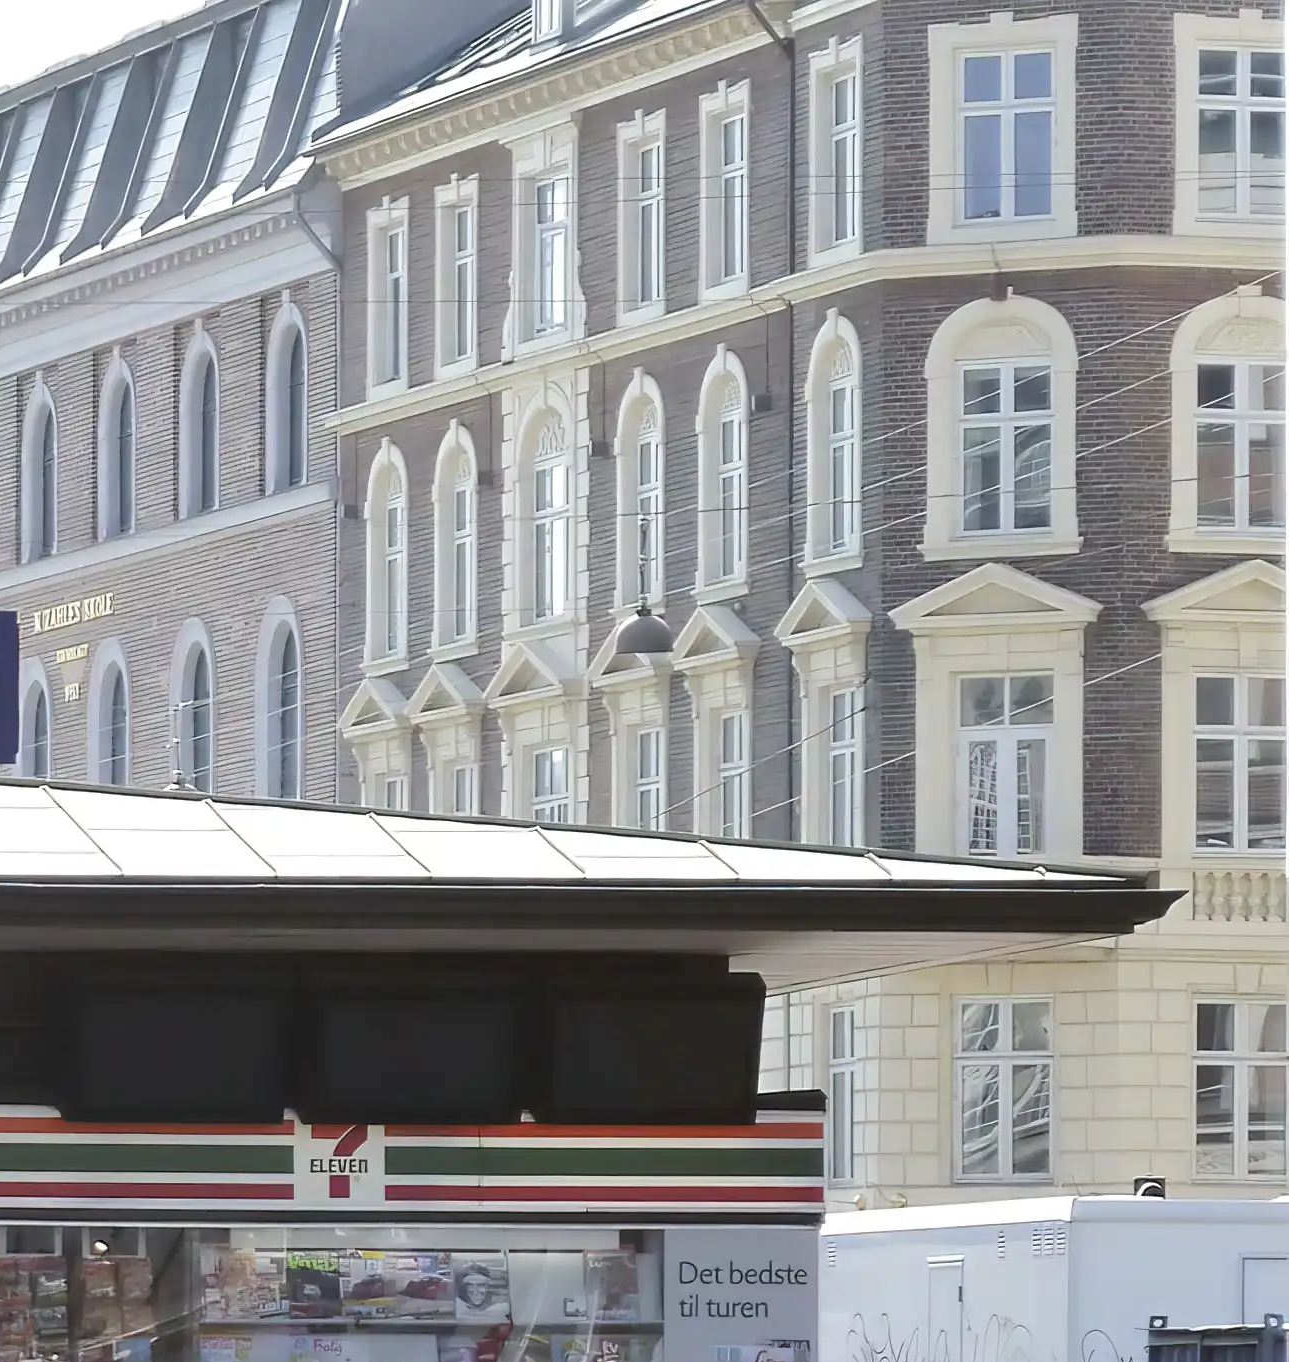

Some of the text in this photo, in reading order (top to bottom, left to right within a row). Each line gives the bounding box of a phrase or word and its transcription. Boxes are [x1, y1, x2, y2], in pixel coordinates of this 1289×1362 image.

[679, 1260, 808, 1285] Det bedste
[679, 1294, 769, 1318] til turen
